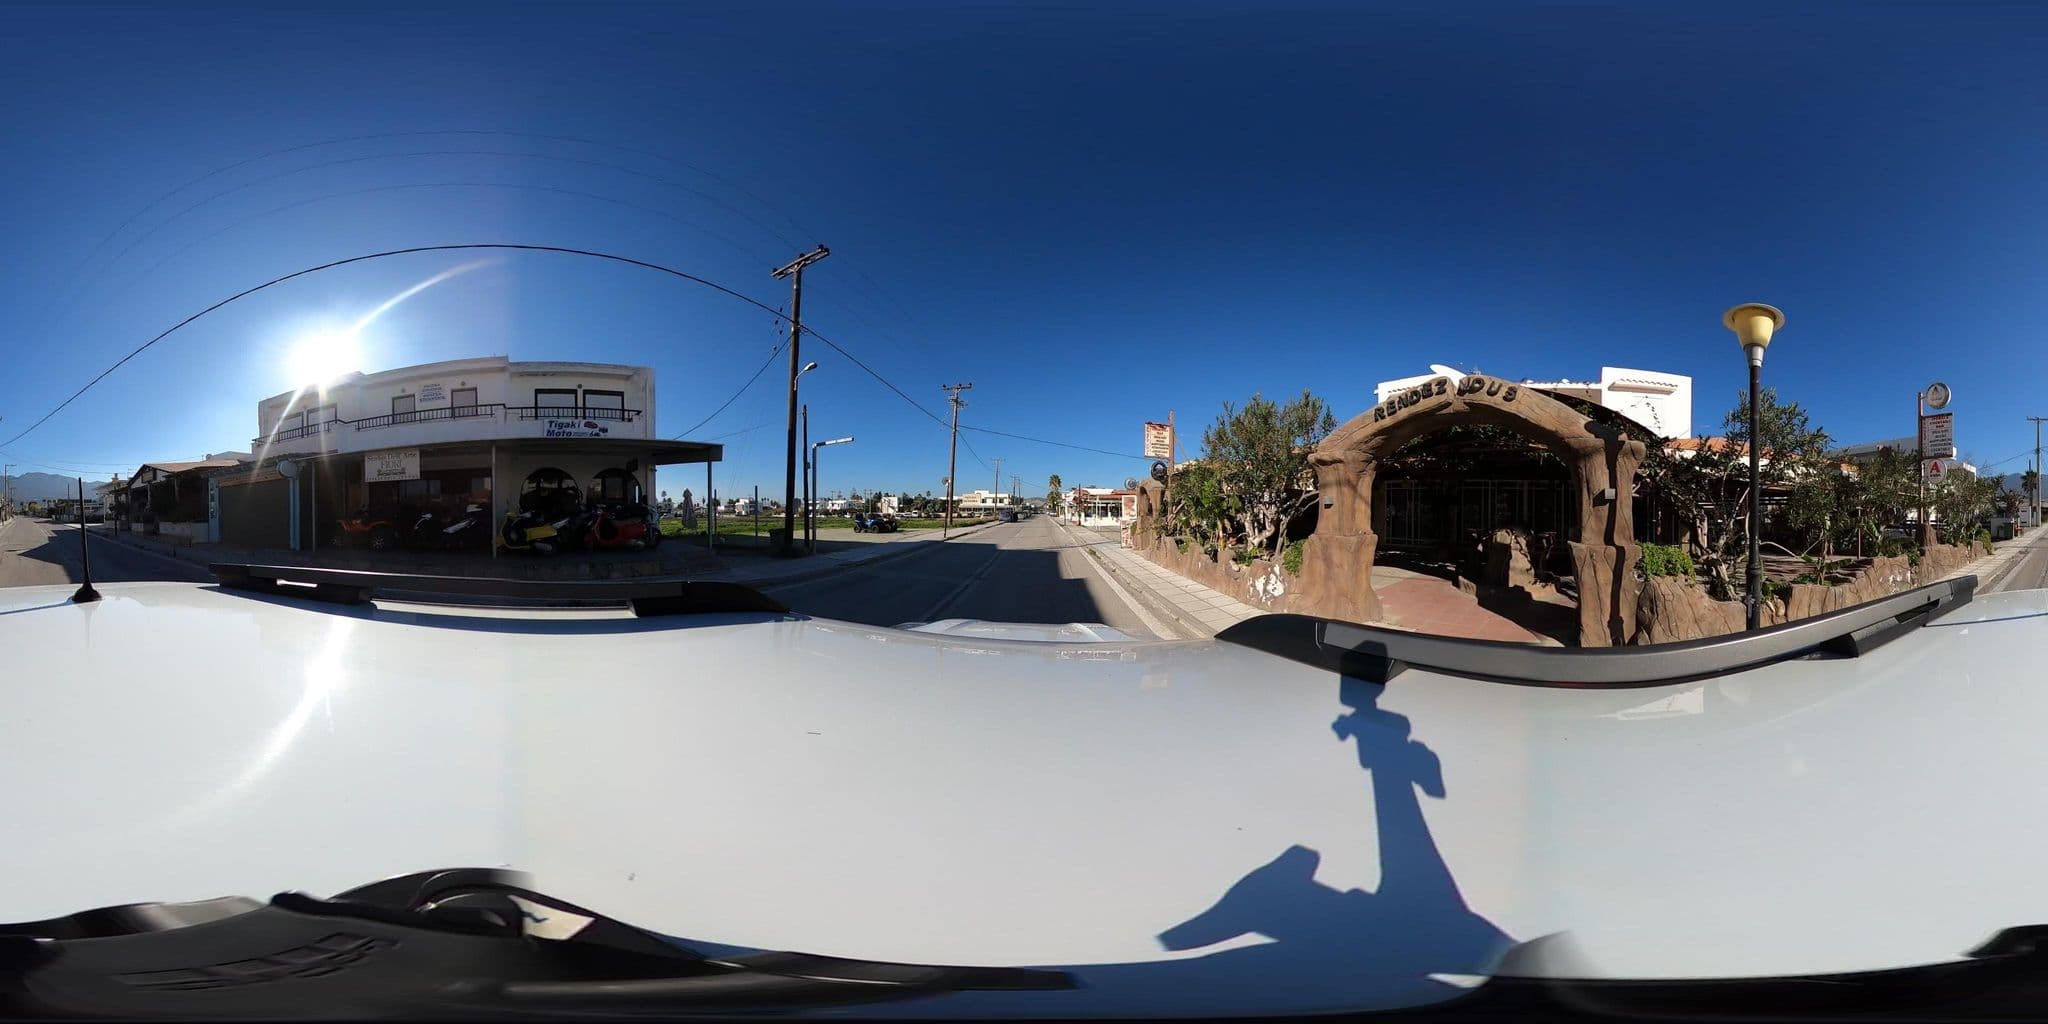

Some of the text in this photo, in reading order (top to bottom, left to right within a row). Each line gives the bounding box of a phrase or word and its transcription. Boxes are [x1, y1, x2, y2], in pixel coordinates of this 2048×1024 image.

[1373, 378, 1447, 422] RENDEZ
[547, 420, 581, 429] Tigaki
[546, 429, 572, 437] Moto
